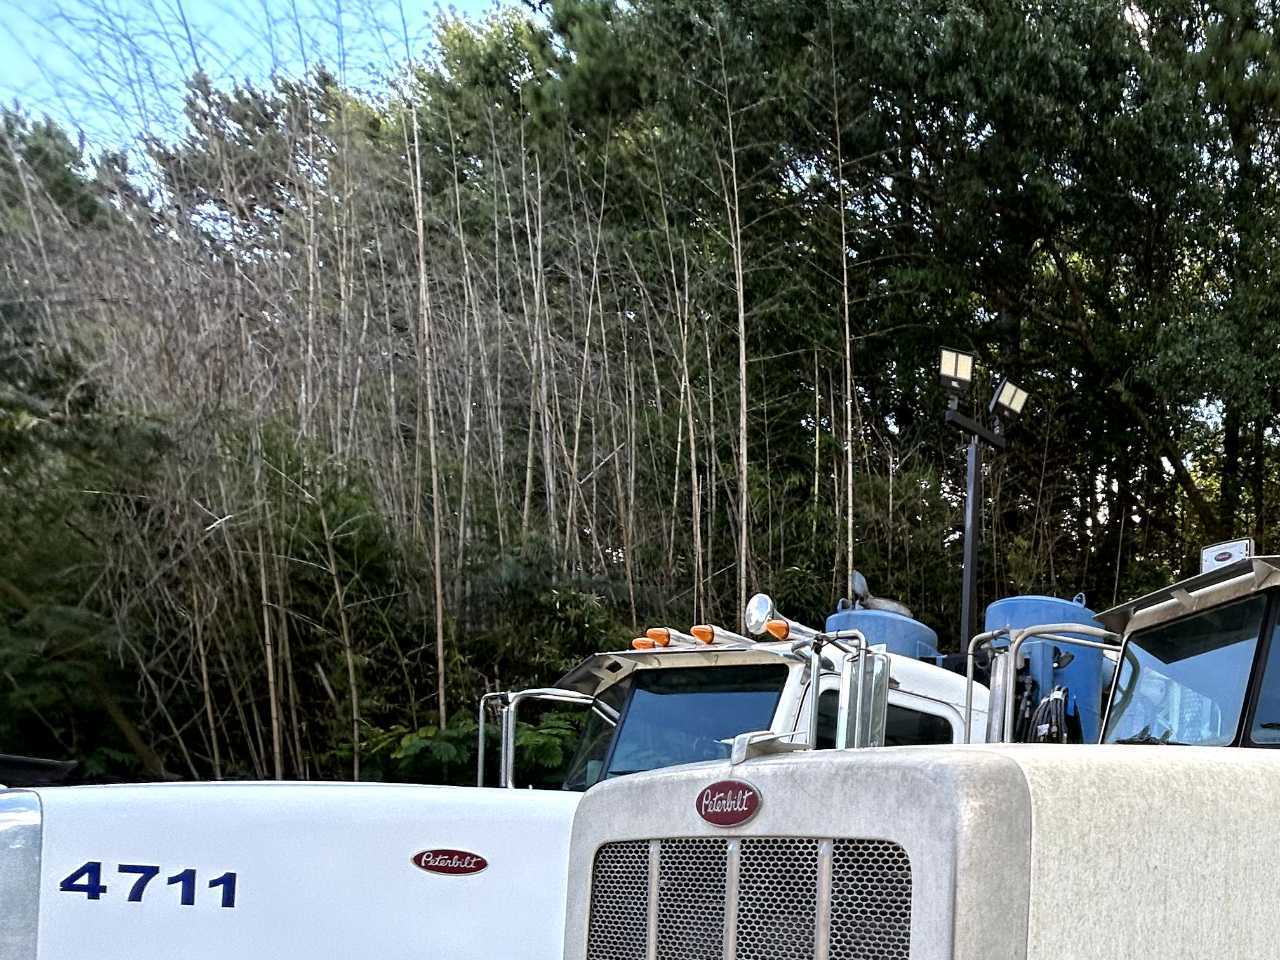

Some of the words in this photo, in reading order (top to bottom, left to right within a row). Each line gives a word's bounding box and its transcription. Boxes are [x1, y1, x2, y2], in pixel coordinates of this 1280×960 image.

[702, 789, 753, 815] Peterbilt
[421, 852, 481, 869] Peterbilt
[60, 861, 237, 908] 4711
